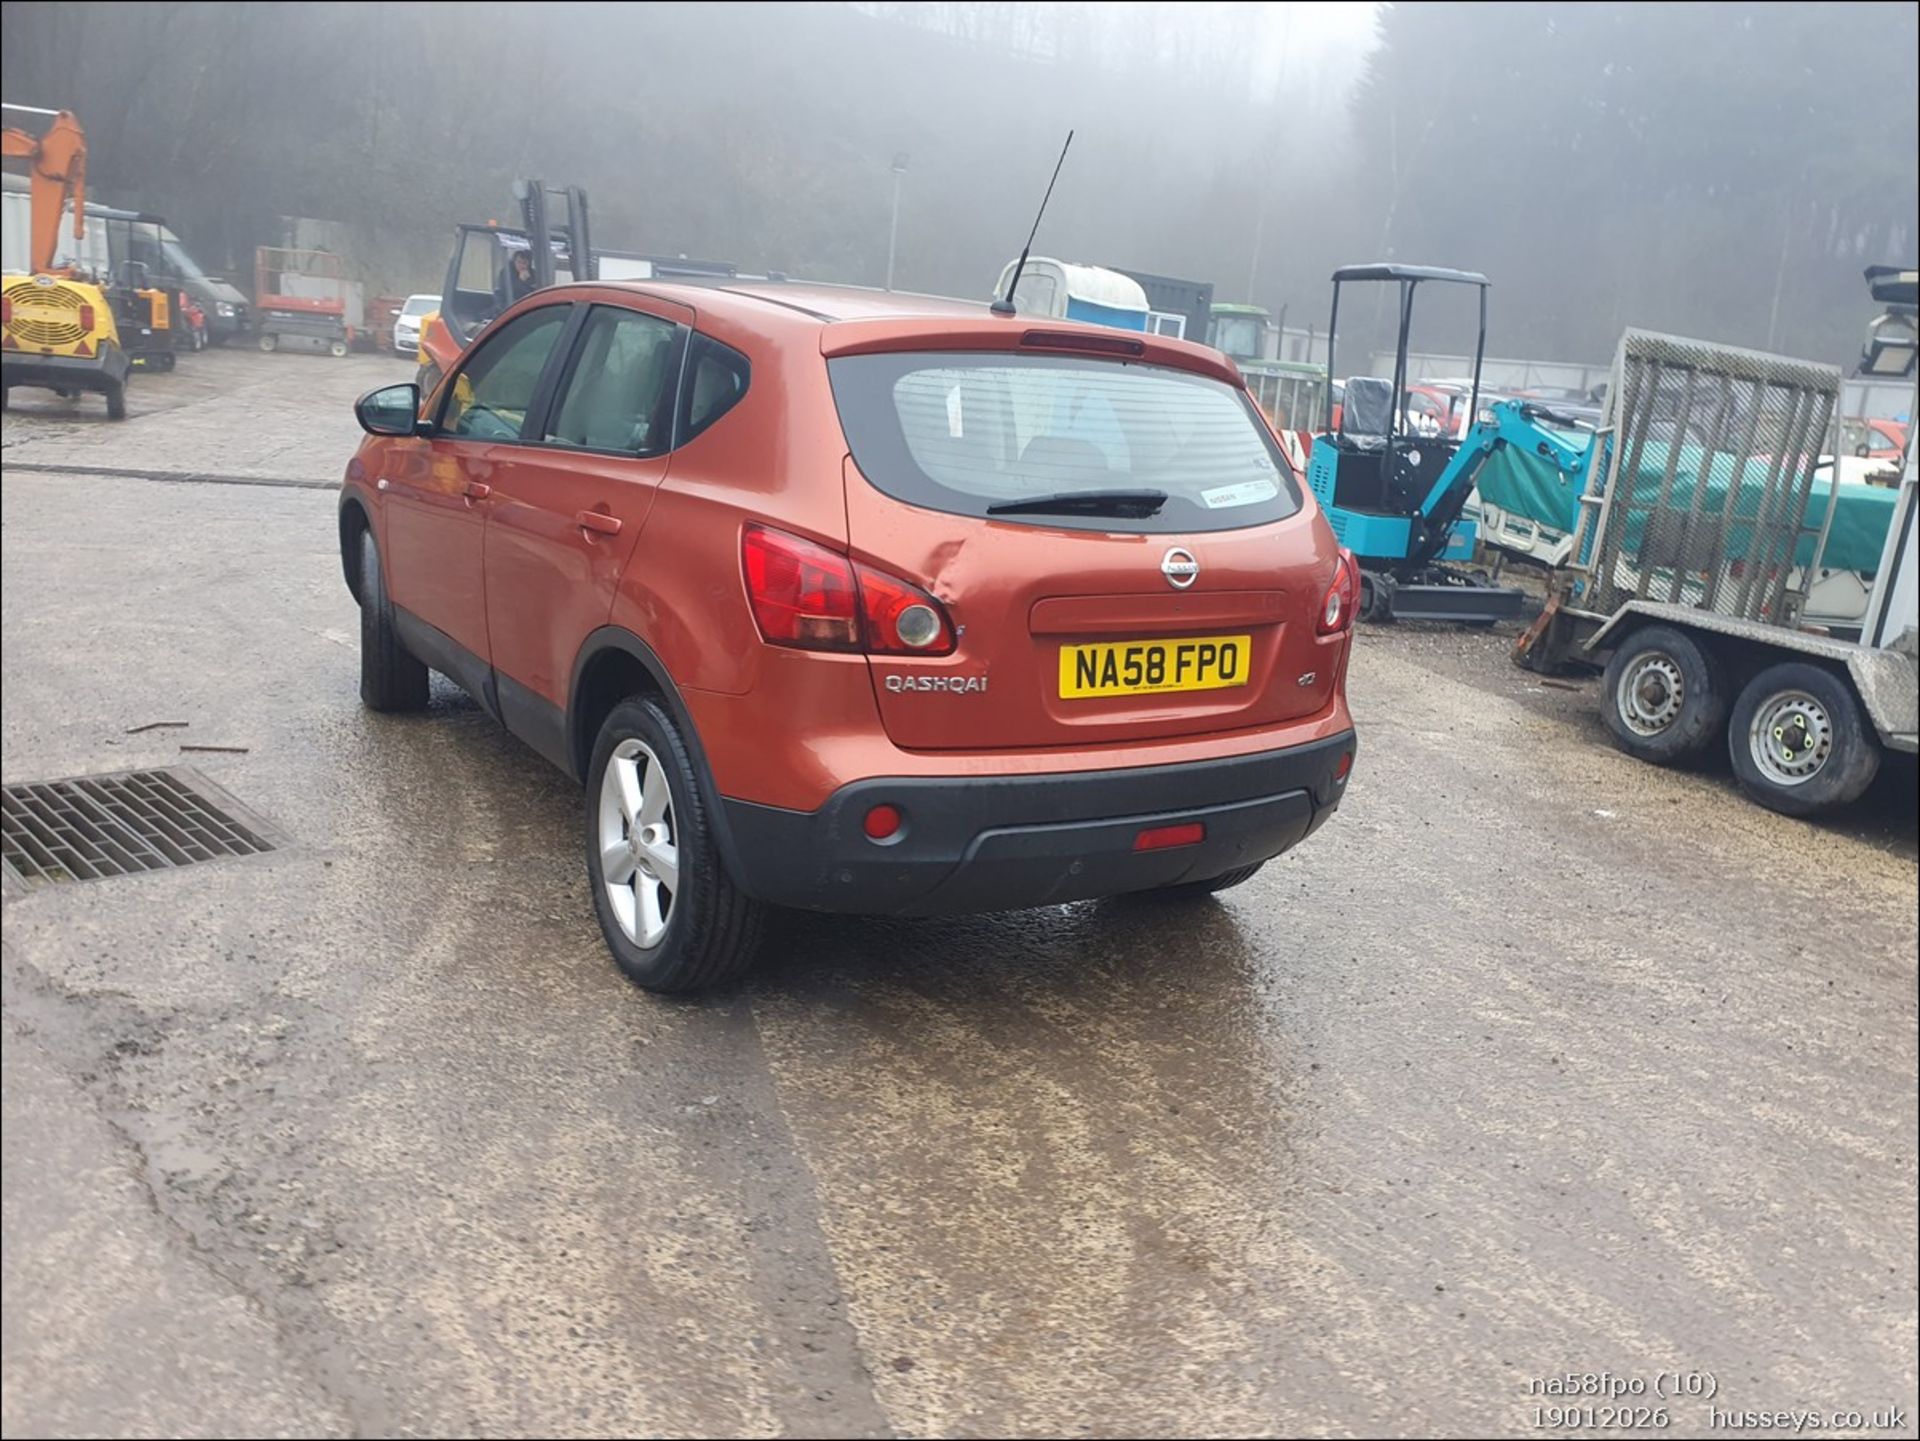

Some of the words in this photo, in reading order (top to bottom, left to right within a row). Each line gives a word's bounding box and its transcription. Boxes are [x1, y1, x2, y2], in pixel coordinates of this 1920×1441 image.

[1076, 646, 1165, 689] NA58
[1175, 643, 1238, 683] FPO
[885, 674, 988, 694] QASHQAI
